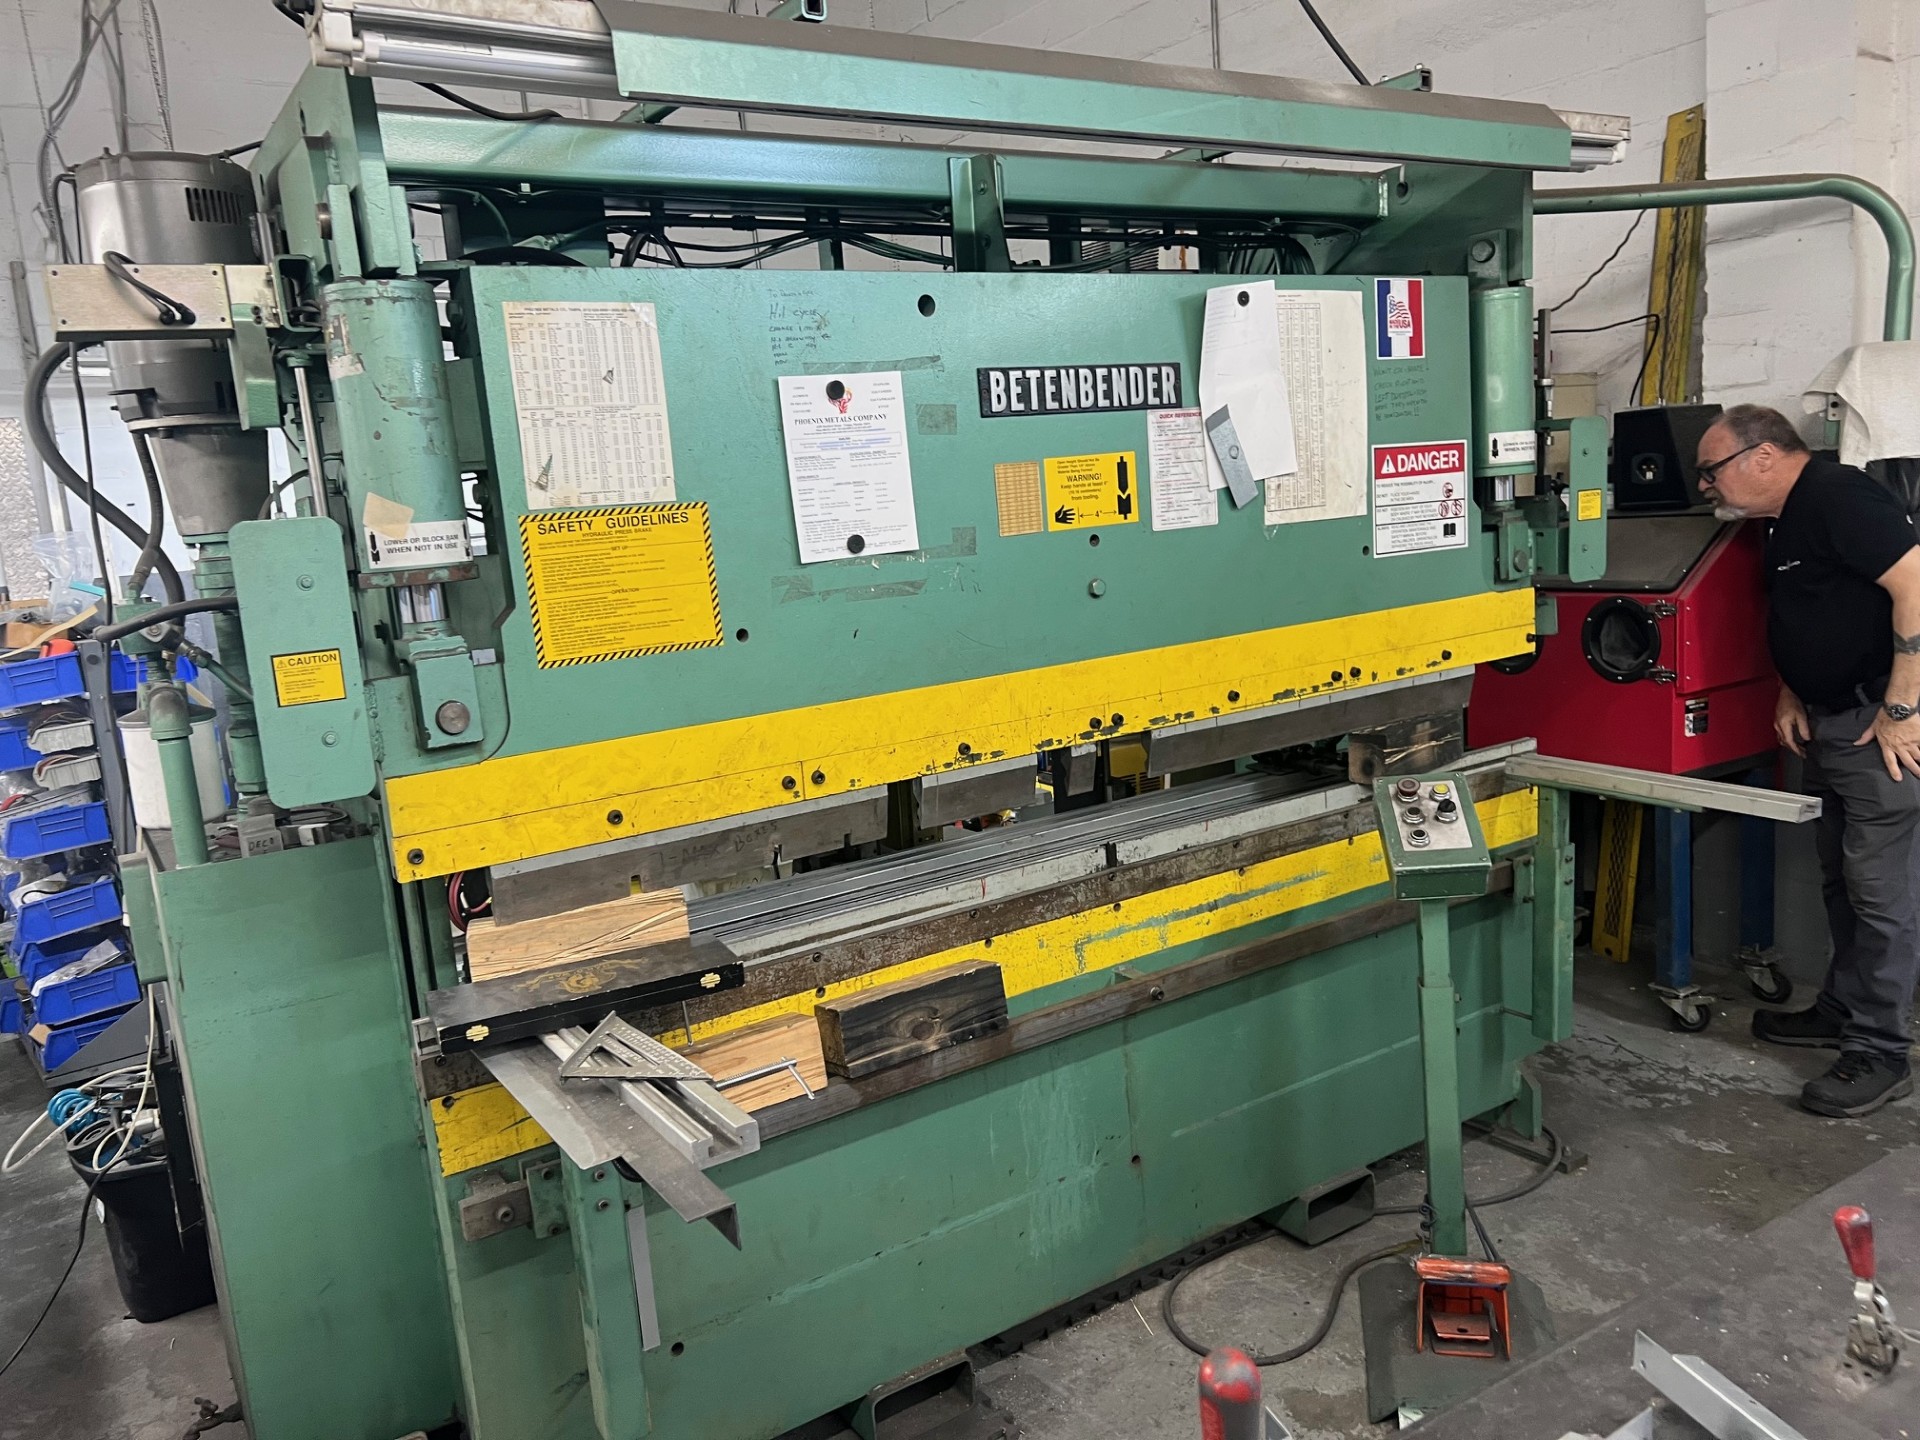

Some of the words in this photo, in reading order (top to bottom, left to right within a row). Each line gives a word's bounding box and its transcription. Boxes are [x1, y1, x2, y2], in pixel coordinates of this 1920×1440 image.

[1400, 320, 1411, 328] USA
[988, 366, 1177, 413] BETENBENDER
[794, 417, 824, 426] PHOENIX
[824, 416, 852, 424] METALS
[853, 413, 888, 422] COMPANY
[1397, 450, 1460, 473] DANGER
[1066, 473, 1102, 482] WARNING!
[537, 520, 594, 536] SAFETY
[606, 511, 689, 530] GUIDELINES
[582, 530, 612, 538] HYDRAULIC
[614, 528, 632, 536] PRESS
[384, 538, 408, 546] LOWER
[422, 535, 444, 543] BLOCK
[386, 546, 413, 554] WHEN
[414, 544, 432, 552] NOT
[288, 653, 337, 667] CAUTION
